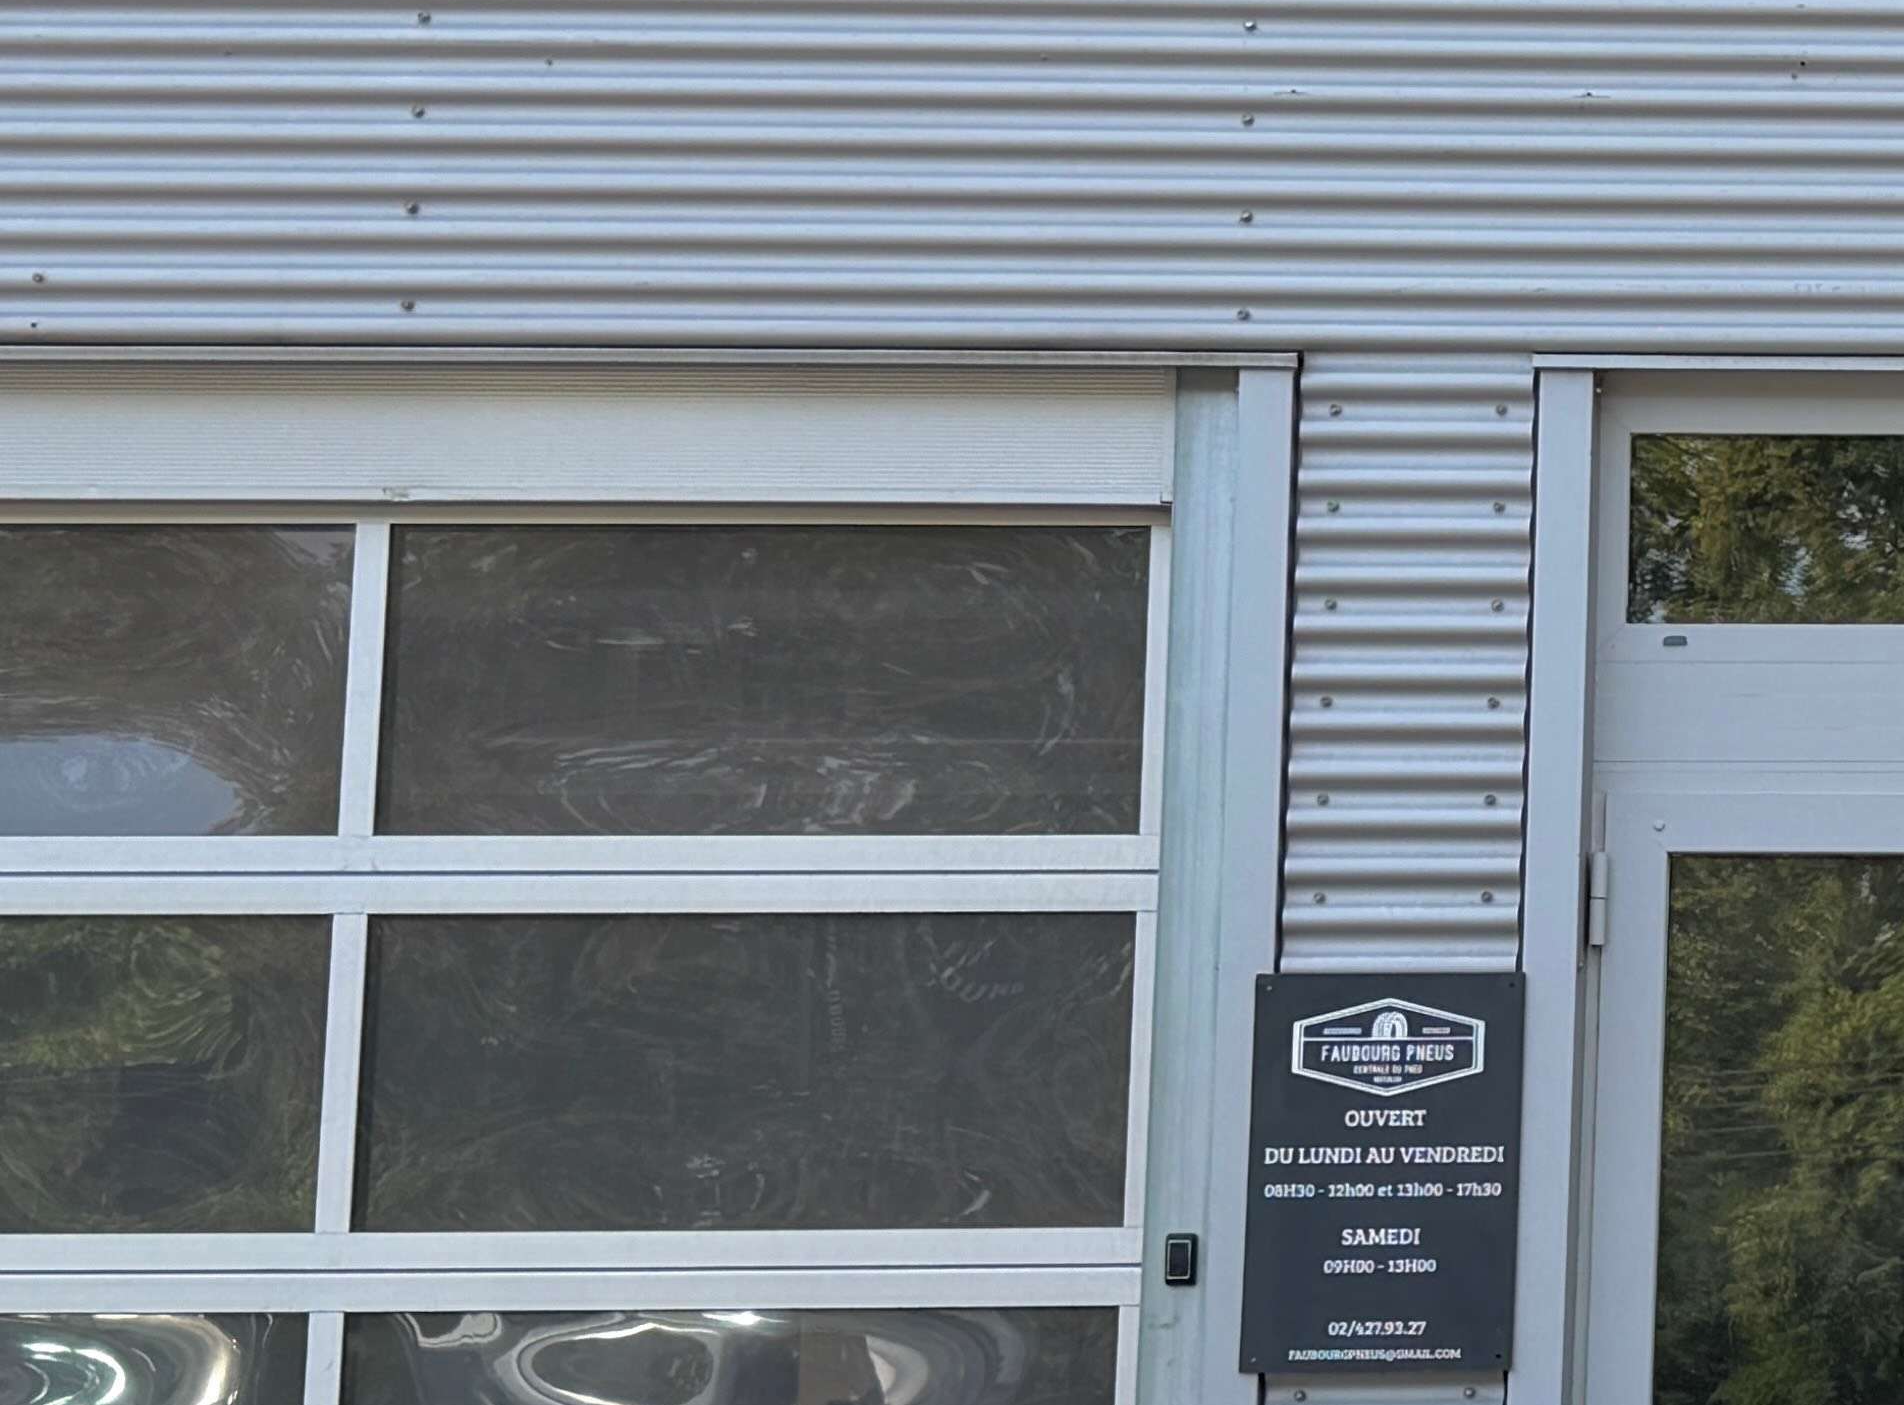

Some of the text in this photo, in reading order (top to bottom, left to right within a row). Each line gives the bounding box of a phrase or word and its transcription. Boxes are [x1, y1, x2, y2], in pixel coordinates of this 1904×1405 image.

[1406, 1043, 1454, 1061] PNEUS
[1344, 1109, 1427, 1127] OUVERT
[1264, 1146, 1504, 1164] DU LUNDI AU VENDREDI
[1327, 1183, 1375, 1198] 12h00
[1377, 1184, 1393, 1197] et
[1456, 1182, 1502, 1196] 17h30
[1341, 1228, 1421, 1246] SAMEDI
[1323, 1259, 1375, 1274] 09H00
[1387, 1258, 1437, 1273] 13H00
